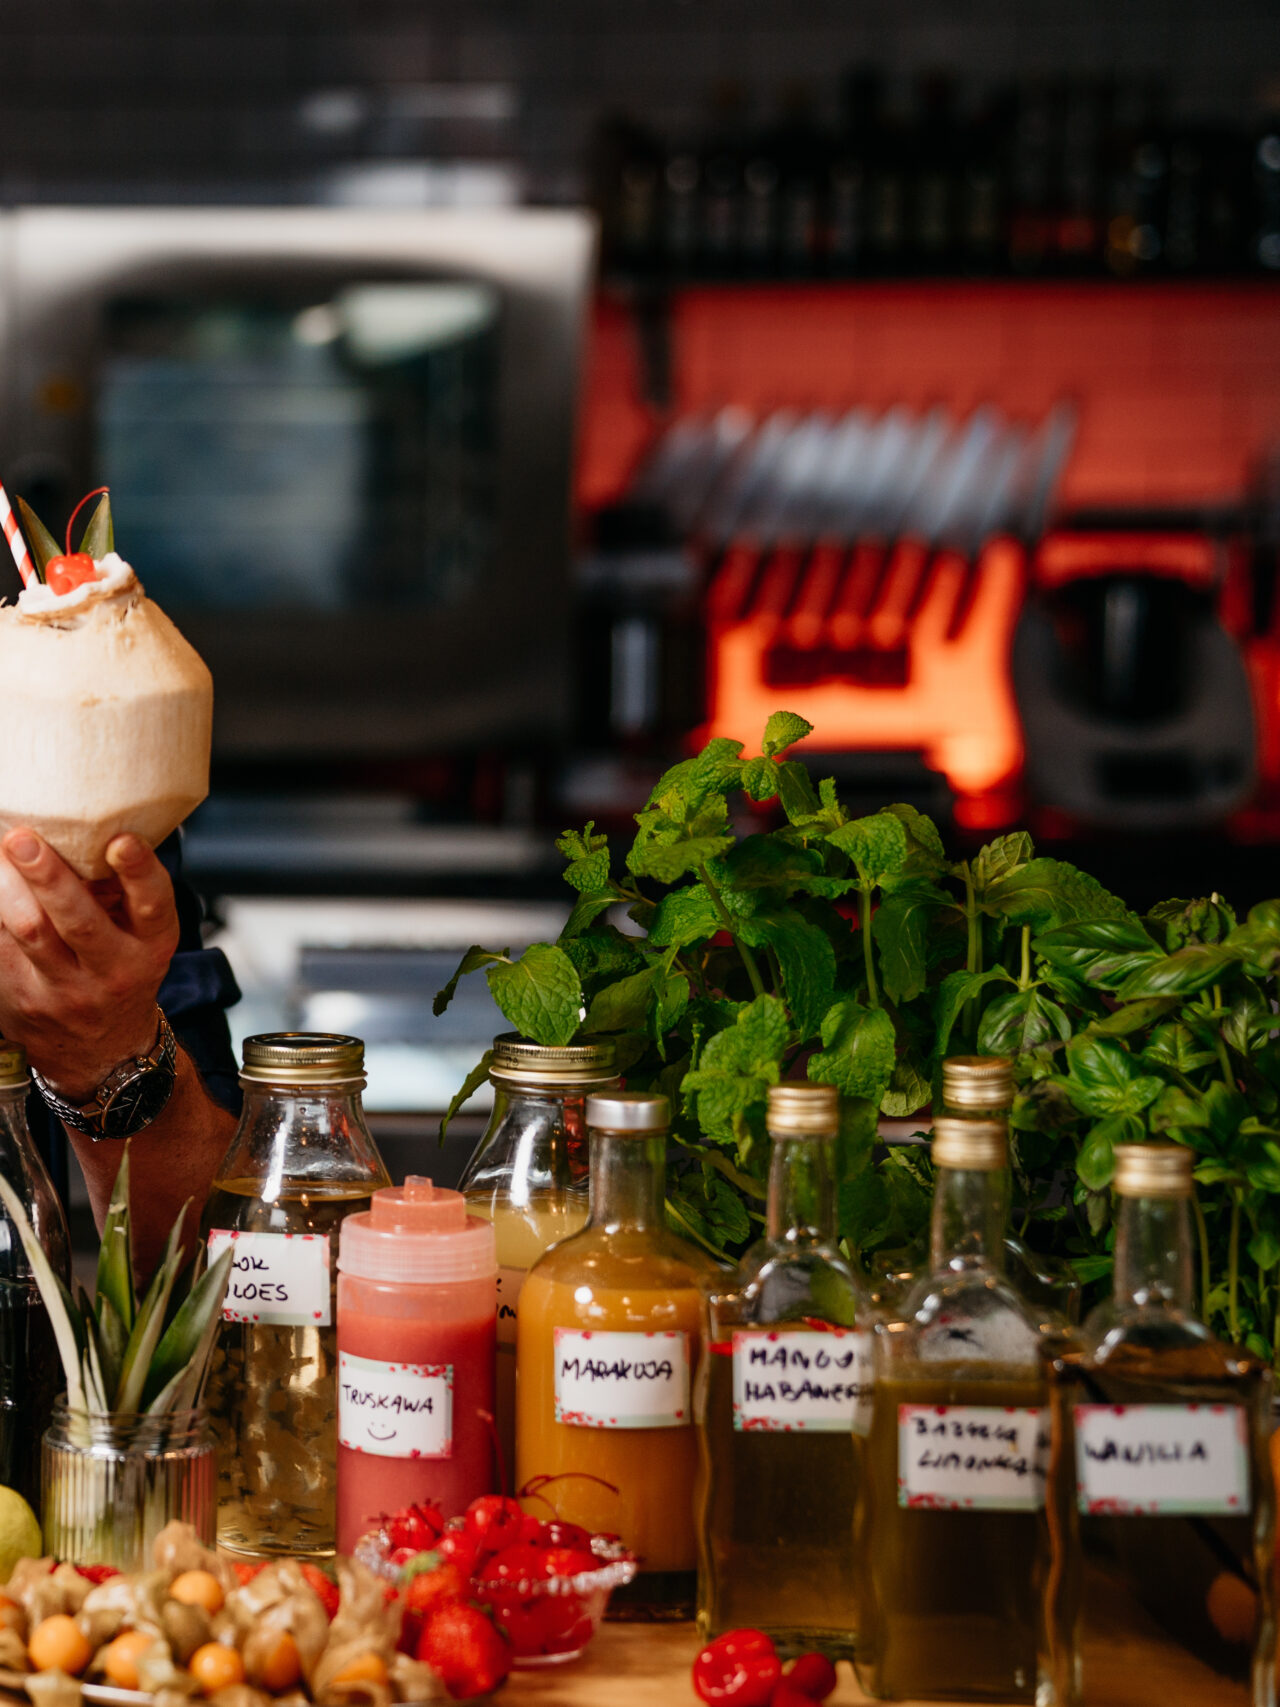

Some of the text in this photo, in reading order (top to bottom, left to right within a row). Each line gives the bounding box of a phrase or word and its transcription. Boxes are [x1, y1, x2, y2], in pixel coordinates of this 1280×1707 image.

[230, 1255, 270, 1272] OK
[224, 1282, 289, 1302] LOES
[342, 1384, 434, 1415] TRUSKAWA
